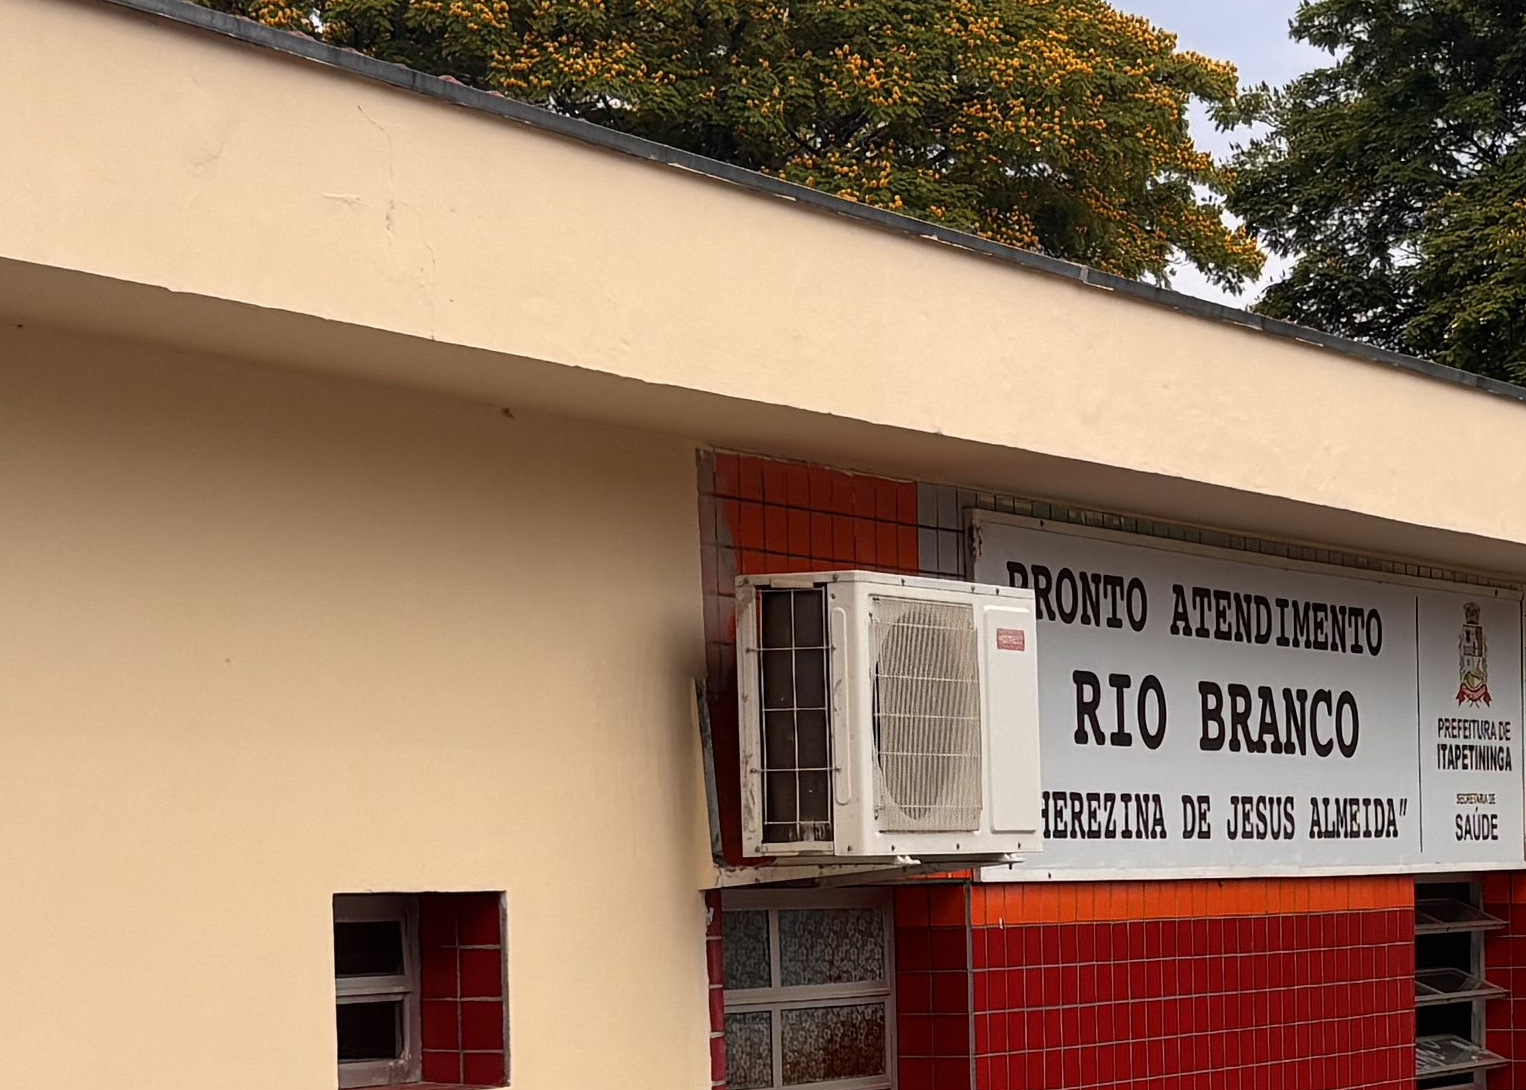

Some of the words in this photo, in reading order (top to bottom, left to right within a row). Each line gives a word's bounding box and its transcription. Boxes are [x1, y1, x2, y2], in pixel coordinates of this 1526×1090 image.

[1170, 584, 1382, 656] ATENDIMENTO
[1072, 669, 1167, 750] RIO
[1198, 681, 1360, 758] BRANCO
[1437, 717, 1497, 740] PREFEITURA
[1498, 721, 1511, 741] DE
[1437, 743, 1512, 771] ITAPETININGA
[1041, 791, 1167, 839] HEREZINA
[1181, 795, 1211, 839] DE
[1226, 795, 1296, 840] JESUS
[1308, 797, 1408, 839] ALMEIDA"
[1455, 806, 1498, 841] SAÚDE
